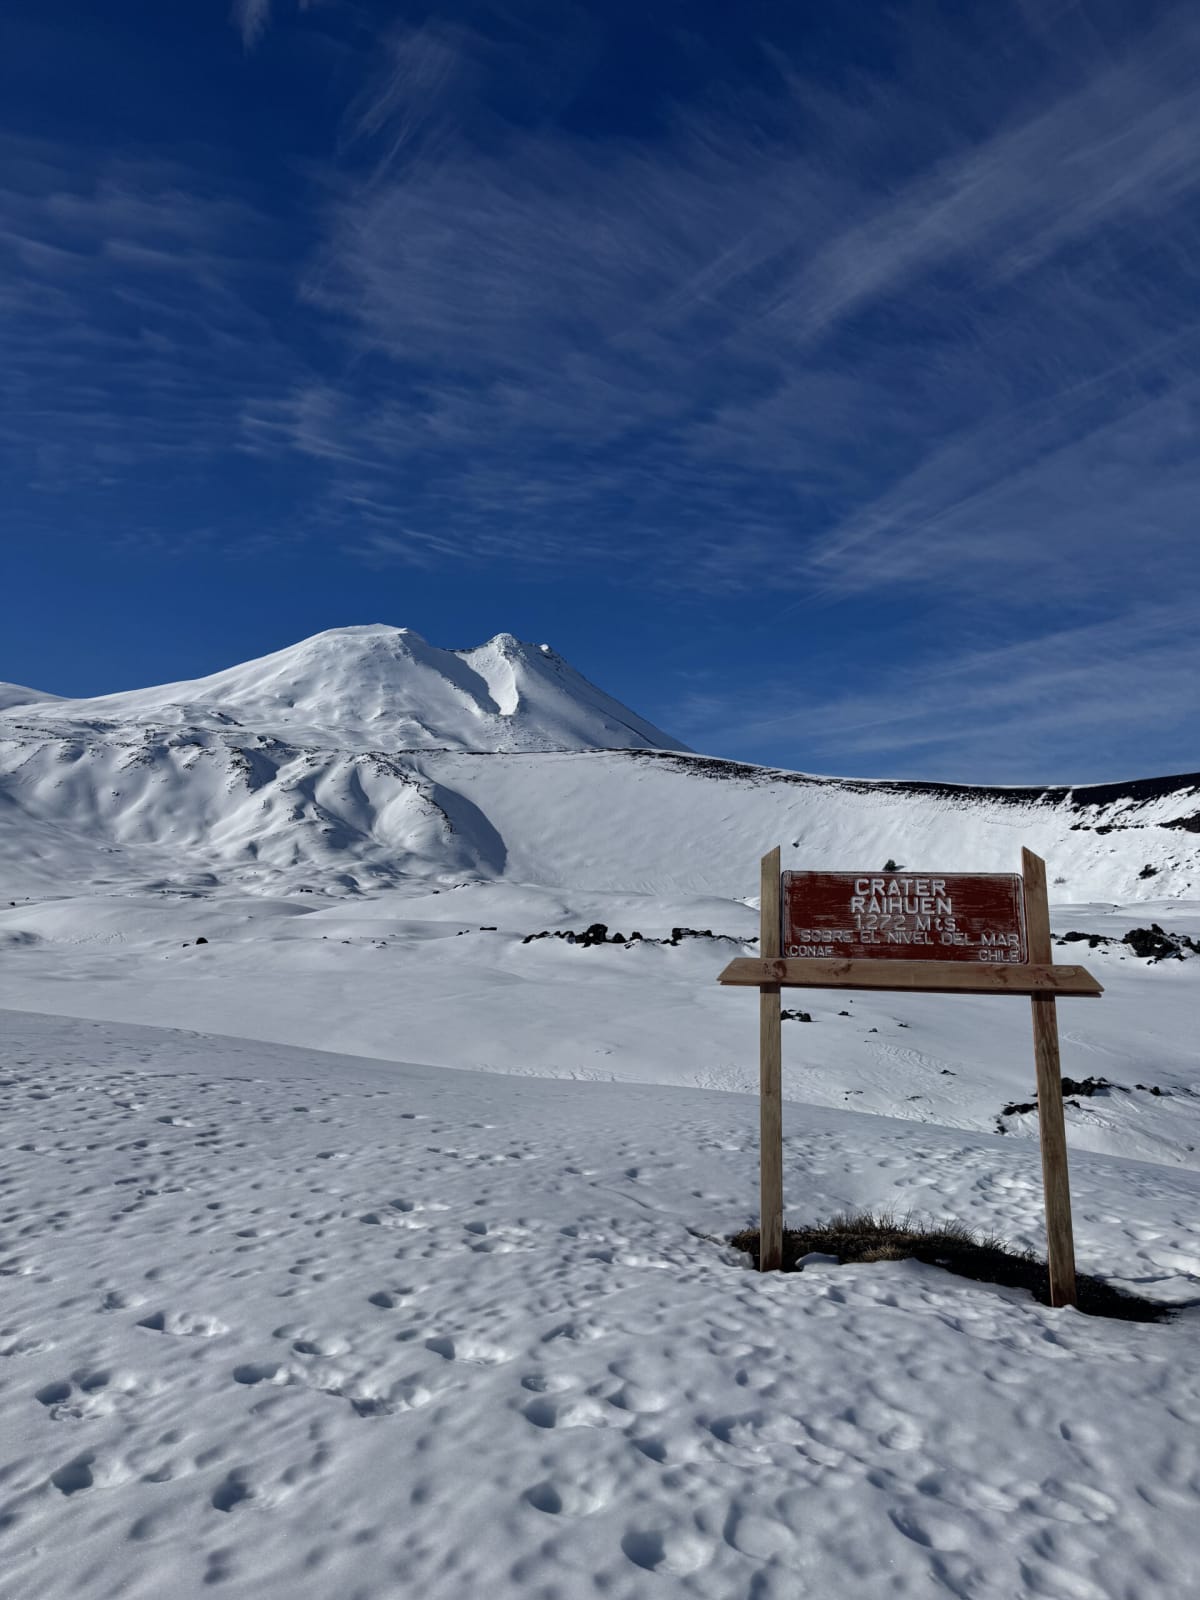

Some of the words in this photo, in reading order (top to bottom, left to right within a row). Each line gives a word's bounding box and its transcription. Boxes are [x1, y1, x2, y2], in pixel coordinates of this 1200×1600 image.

[855, 878, 946, 897] CRATER
[851, 896, 952, 915] RAIHUEN
[800, 930, 853, 943] SOBRE
[860, 930, 880, 944] EL
[887, 931, 934, 945] NIVEL
[941, 932, 974, 946] DEL
[981, 933, 1019, 947] MAR
[788, 945, 834, 957] CONAF
[979, 949, 1020, 962] CHILE
